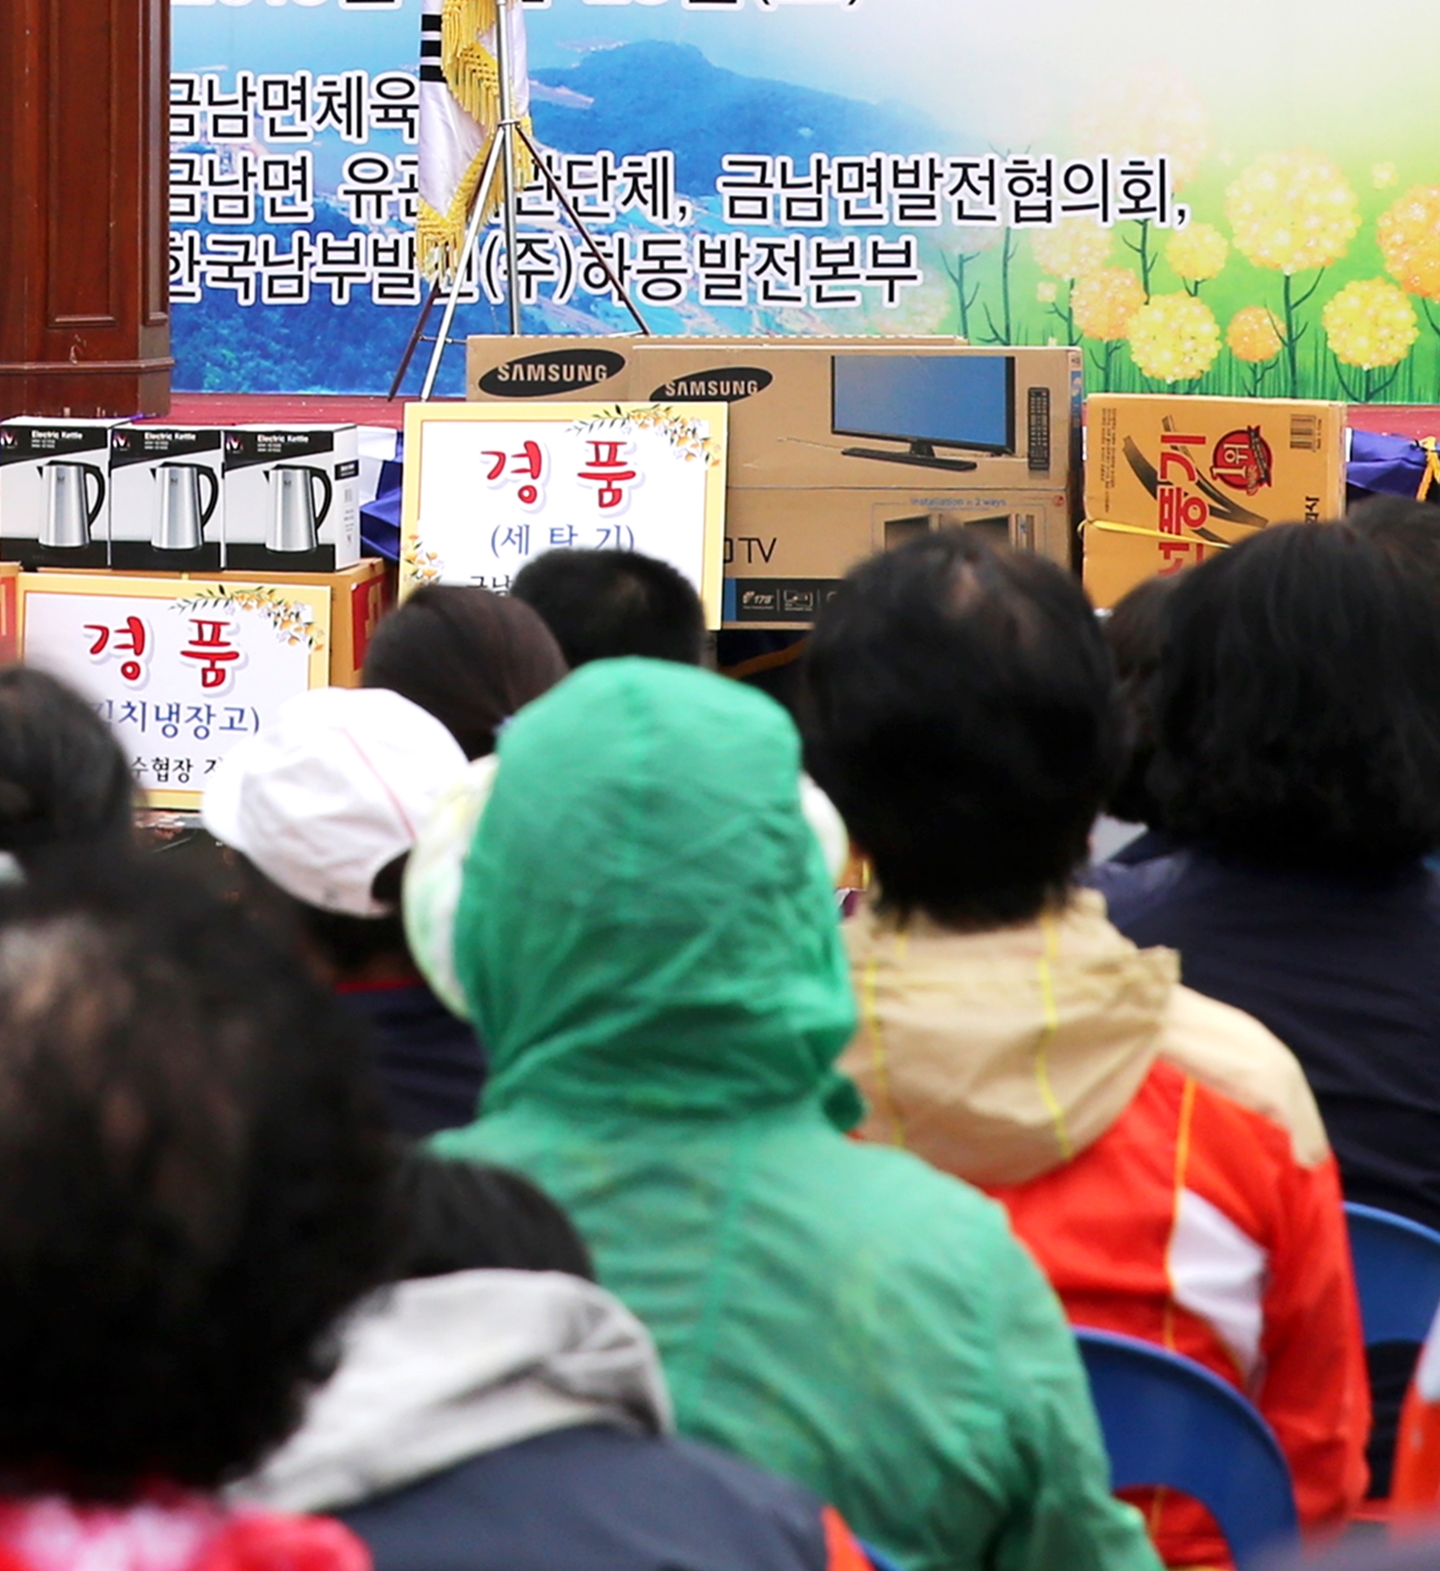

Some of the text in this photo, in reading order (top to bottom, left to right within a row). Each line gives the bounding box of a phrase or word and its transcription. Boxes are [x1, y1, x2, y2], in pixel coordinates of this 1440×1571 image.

[720, 155, 1188, 226] 금남면발전협의회,
[497, 363, 609, 382] SAMSUNG
[664, 380, 760, 397] SAMSUNG
[739, 537, 778, 564] TV
